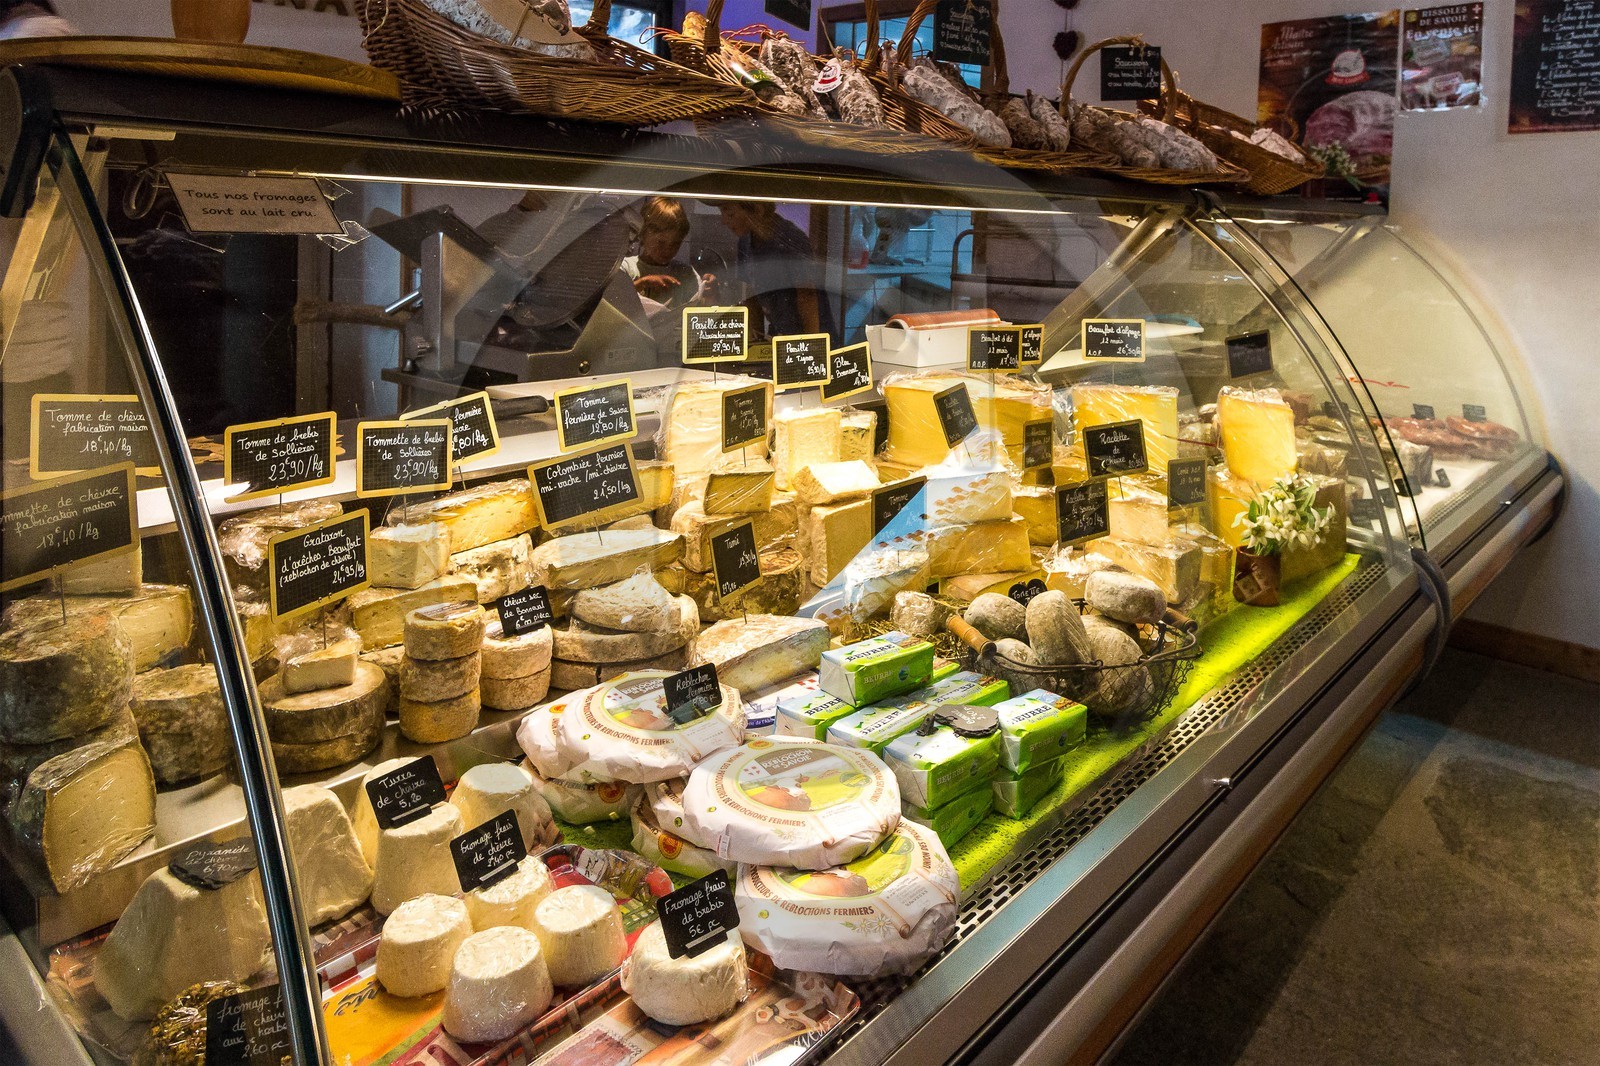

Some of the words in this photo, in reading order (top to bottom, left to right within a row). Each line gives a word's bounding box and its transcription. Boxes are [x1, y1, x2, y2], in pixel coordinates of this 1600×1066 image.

[1422, 6, 1467, 17] RISSOLES
[1434, 14, 1468, 24] SAVOIE
[1464, 24, 1479, 33] ici
[183, 189, 219, 200] Tous
[225, 191, 249, 201] nos
[253, 191, 317, 204] fromages
[202, 207, 234, 216] sont
[262, 206, 286, 217] lait
[719, 321, 728, 329] de
[1088, 324, 1115, 336] Beaufort
[981, 332, 1001, 346] Beaufort
[996, 346, 1008, 354] mois
[786, 356, 793, 364] de
[576, 396, 609, 408] Tomme
[45, 409, 93, 422] Tomme
[98, 411, 112, 421] de
[564, 410, 596, 429] fermière
[597, 409, 607, 420] de
[63, 422, 115, 436] fabrication
[237, 437, 271, 450] Tomme
[274, 433, 286, 444] de
[290, 425, 319, 442] brebis
[366, 432, 409, 447] Tommette
[412, 434, 421, 444] de
[424, 431, 445, 444] brebis
[1099, 430, 1130, 445] Raclette
[1112, 445, 1120, 454] de
[546, 459, 592, 481] Colombier
[596, 450, 625, 469] fermier
[540, 475, 581, 494] mi-vache
[57, 495, 73, 507] de
[80, 485, 120, 503] chèvre
[14, 510, 79, 536] fabrication
[303, 528, 346, 548] Grataron
[328, 537, 361, 557] Beaufort
[279, 564, 319, 588] (reblochon
[320, 561, 330, 570] de
[331, 550, 356, 566] chèvre)
[529, 592, 542, 600] sec
[504, 609, 514, 619] de
[844, 643, 896, 662] BEURRE
[676, 671, 711, 691] Reblochon
[863, 670, 894, 684] BEURRE
[640, 738, 675, 746] FERMIERS
[762, 748, 813, 770] REBLOCHON
[782, 755, 811, 769] SAVOIE
[379, 769, 416, 789] Turra
[937, 766, 966, 786] BEURRE
[377, 796, 393, 809] de
[394, 778, 427, 799] chèvre
[728, 798, 769, 822] REBLOCHONS
[768, 814, 806, 827] FERMIERS
[460, 831, 493, 854] Fromage
[494, 819, 514, 840] frais
[186, 844, 251, 861] Pyramide
[473, 851, 485, 865] de
[488, 837, 514, 857] chèvre
[664, 890, 704, 914] Fromage
[704, 877, 726, 900] frais
[682, 912, 694, 925] de
[694, 896, 724, 918] brebis
[771, 894, 782, 904] DE
[780, 900, 831, 916] REBLOCHONS
[833, 905, 875, 916] FERMIERS
[688, 925, 704, 937] 5€
[217, 996, 271, 1024] fromage
[232, 1018, 247, 1032] de
[223, 1037, 244, 1047] aux
